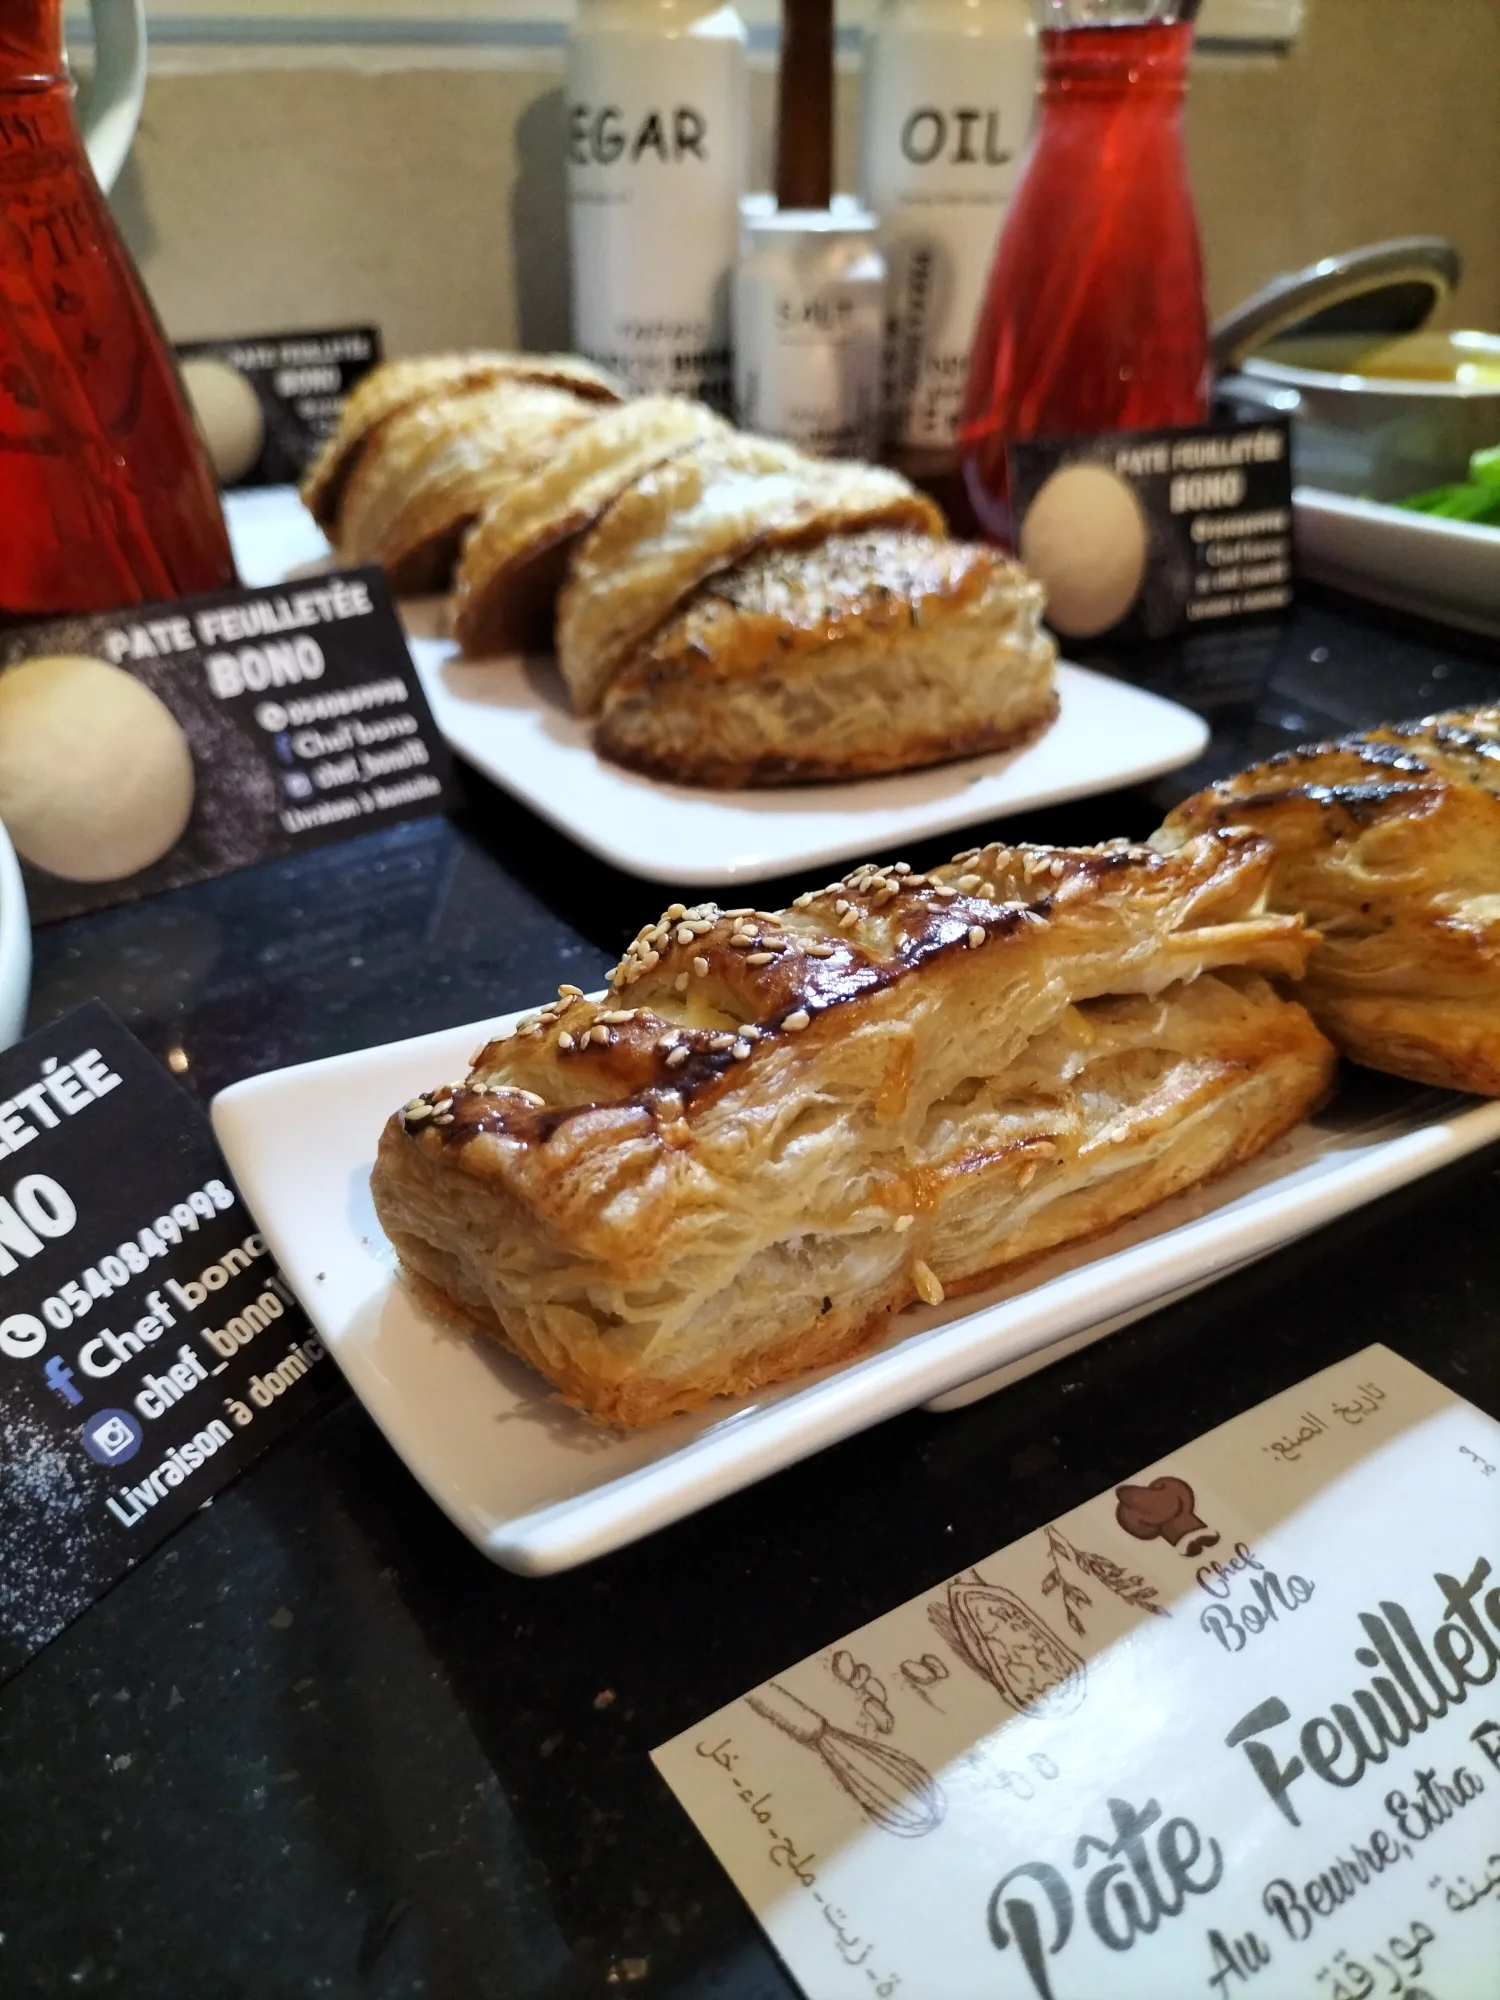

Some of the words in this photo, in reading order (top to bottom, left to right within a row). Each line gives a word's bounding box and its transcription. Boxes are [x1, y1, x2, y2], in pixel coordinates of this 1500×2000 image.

[899, 106, 1016, 167] OIL
[102, 616, 196, 664] PATE
[196, 574, 374, 645] FEUILLETÉE
[206, 635, 326, 699] BONO
[43, 1179, 235, 1329] 0540849998
[78, 1290, 177, 1379] Chef
[165, 1233, 269, 1312] bono
[106, 1418, 234, 1528] Livraison
[224, 1397, 254, 1427] à
[1195, 1542, 1266, 1600] Chef
[986, 1797, 1224, 2000] Pâte
[1206, 1929, 1271, 2000] Au
